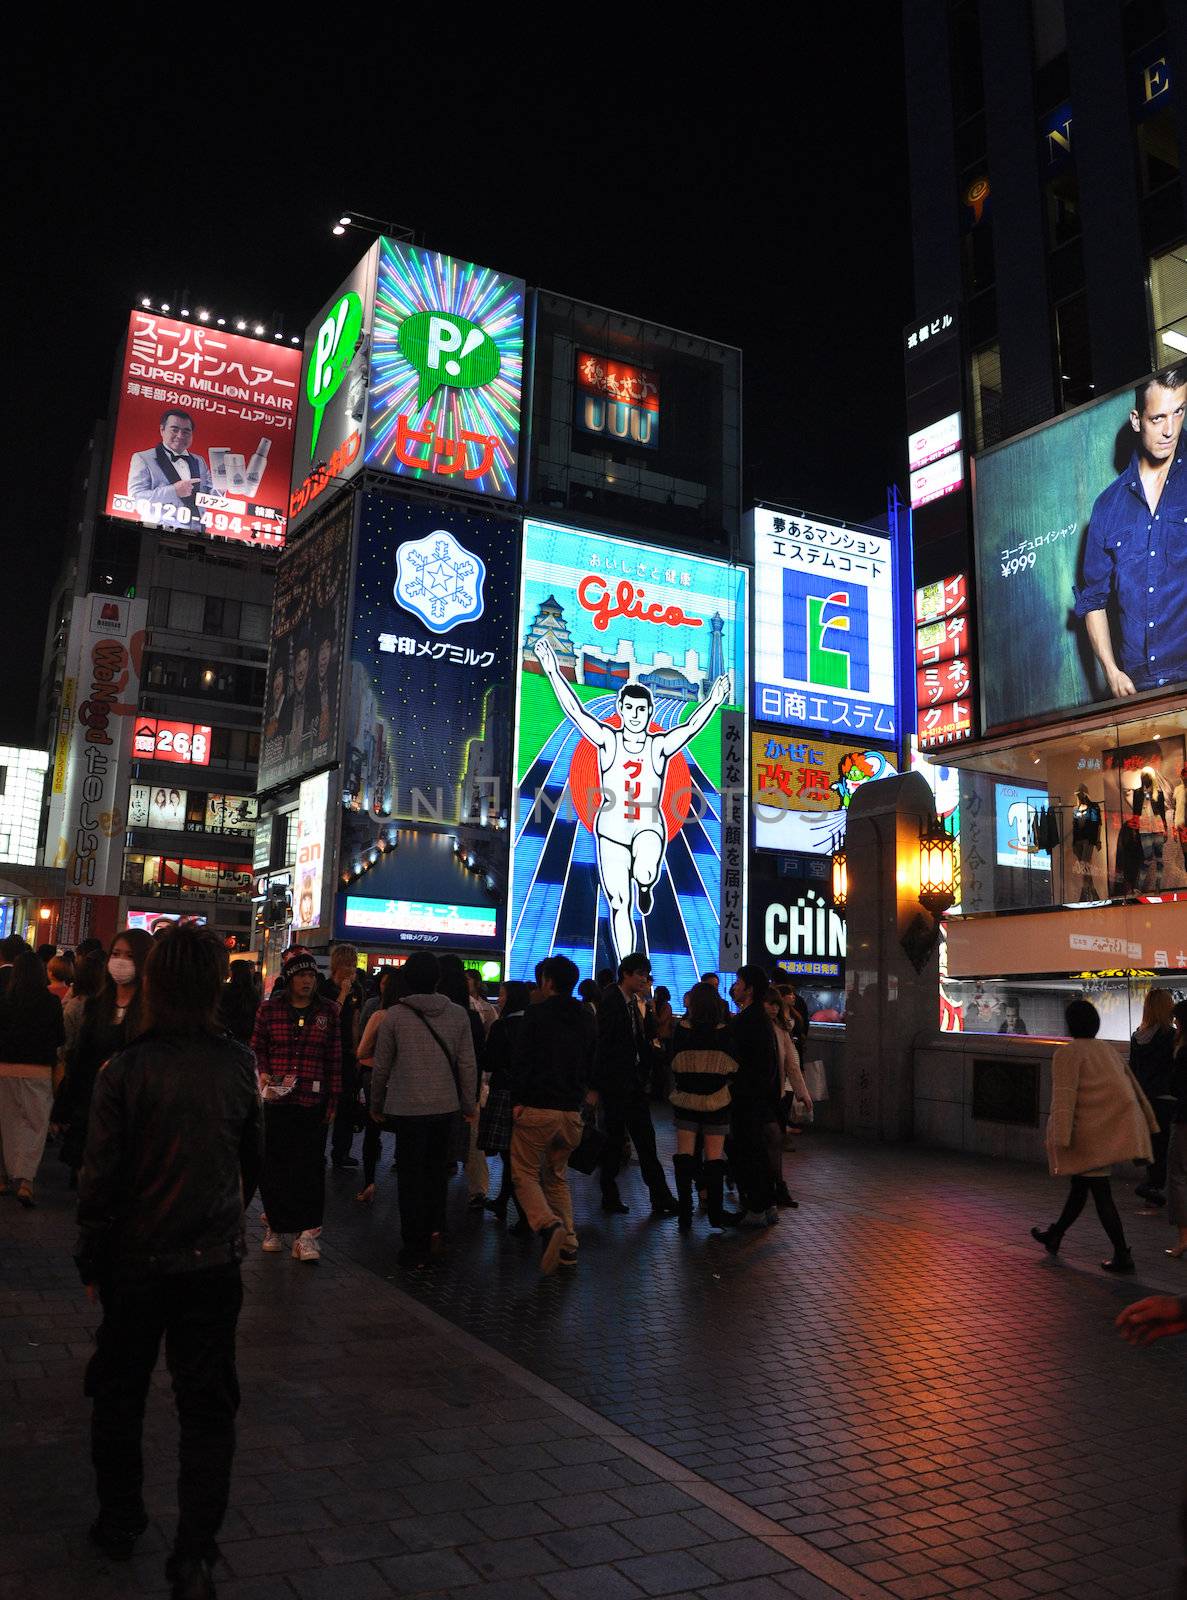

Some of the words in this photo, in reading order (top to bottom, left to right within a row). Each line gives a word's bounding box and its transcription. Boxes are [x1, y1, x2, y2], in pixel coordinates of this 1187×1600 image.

[133, 316, 227, 351] スーパー
[132, 338, 295, 388] ミリオンヘアー
[129, 362, 185, 385] SUPER
[189, 376, 249, 400] MILLION
[253, 392, 293, 411] HAIR
[396, 413, 499, 480] ピップ
[773, 516, 881, 556] 夢あるマンション
[1001, 522, 1078, 561] コーデュロイシャツ
[588, 553, 691, 586] おいしさと健康
[773, 540, 881, 578] エステムコート
[1001, 552, 1037, 579] ¥999
[577, 575, 703, 631] Glico
[378, 632, 495, 668] 雪印メグミルク
[944, 574, 970, 723] インターネット
[922, 645, 944, 729] コミック
[761, 687, 895, 734] 日商エステム
[764, 738, 827, 766] かぜに
[623, 757, 643, 820] グリコ
[757, 762, 832, 801] 改源
